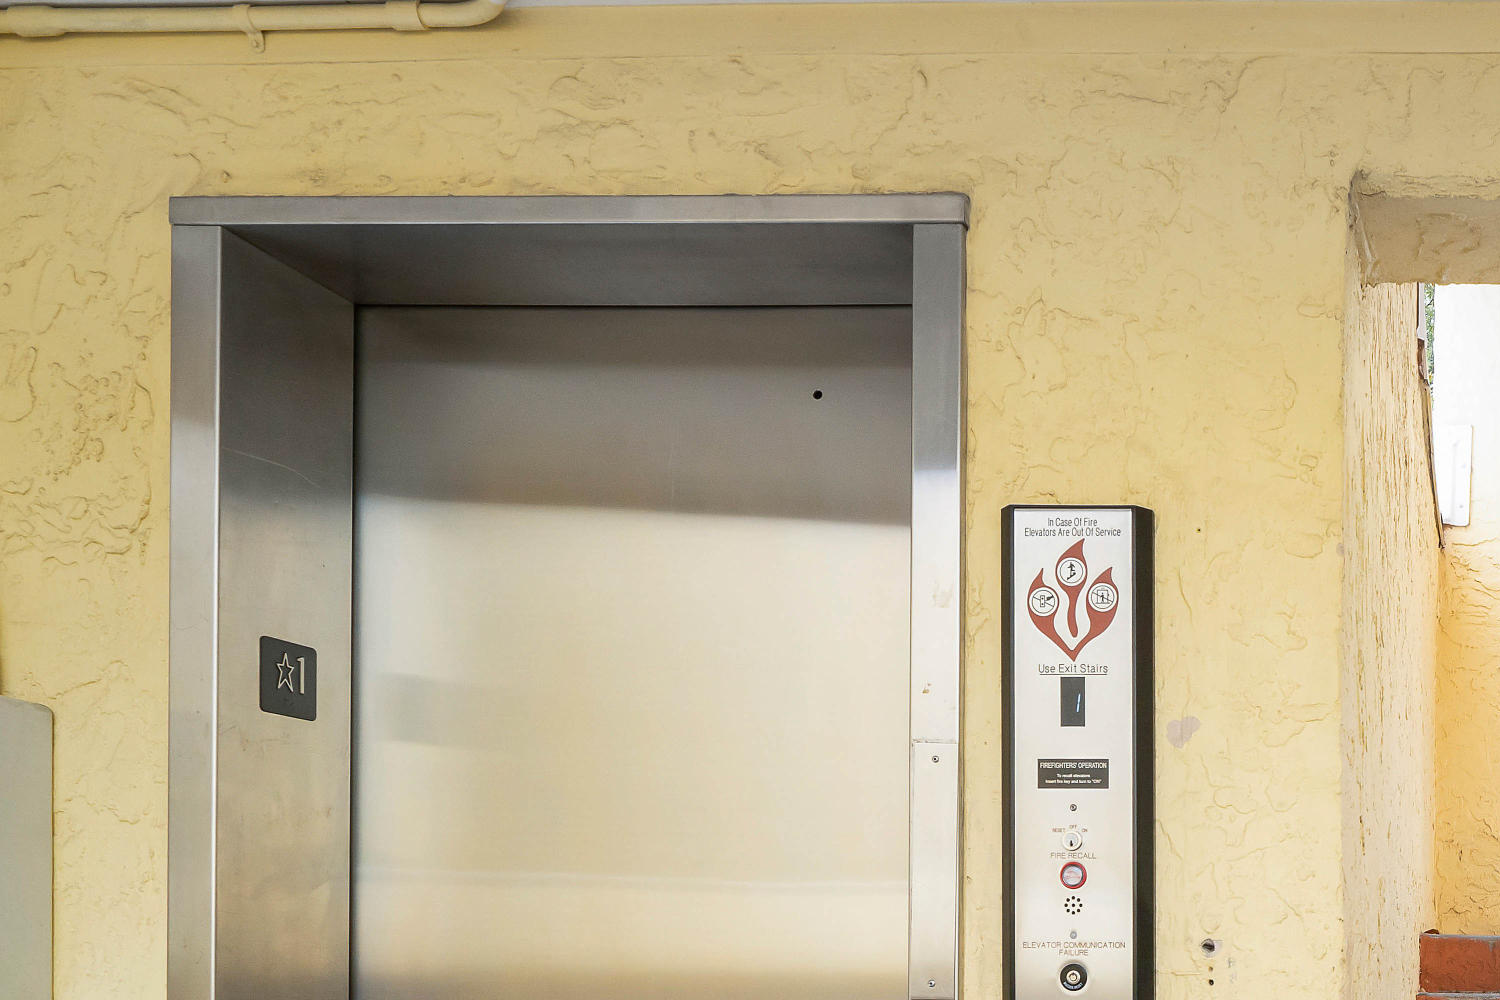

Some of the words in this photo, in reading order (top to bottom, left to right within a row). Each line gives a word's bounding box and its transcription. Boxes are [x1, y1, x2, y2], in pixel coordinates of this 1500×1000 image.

[1048, 518, 1054, 526] In
[1056, 518, 1072, 526] Case
[1074, 518, 1082, 526] Of
[1084, 518, 1098, 526] Fire
[1024, 528, 1056, 536] Elevators
[1058, 528, 1070, 536] Are
[1072, 528, 1084, 536] Out
[1086, 528, 1094, 536] Of
[1096, 528, 1121, 536] Service
[1038, 664, 1056, 673] Use
[1058, 664, 1077, 673] Exit
[1080, 664, 1108, 673] Stairs
[297, 657, 304, 694] 1
